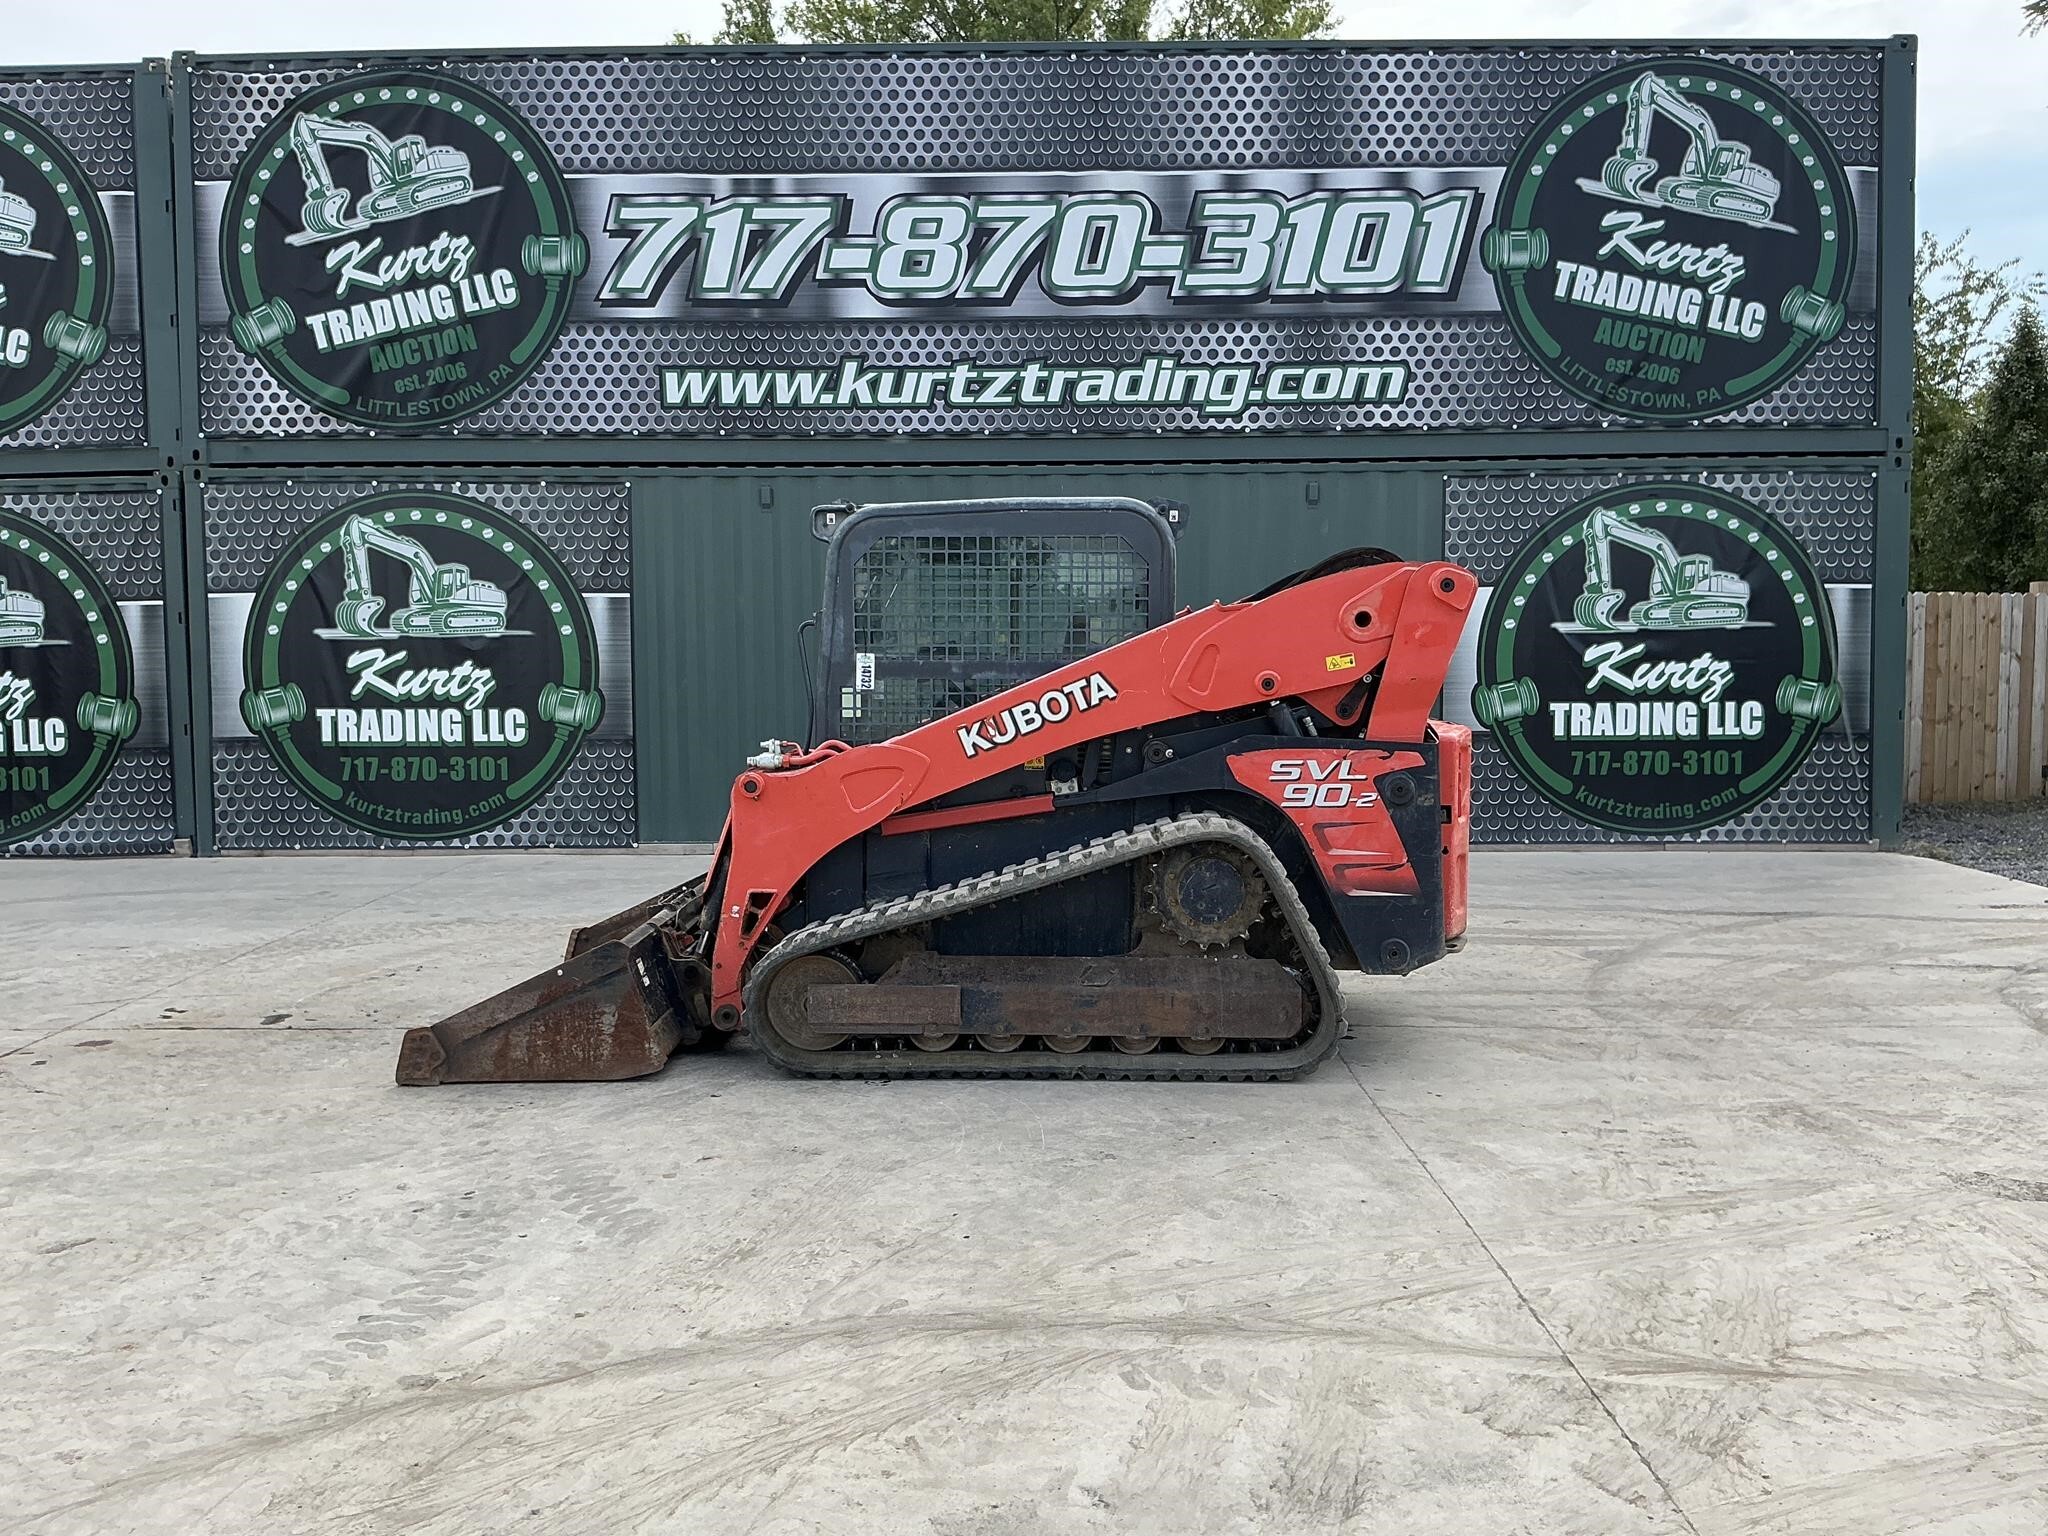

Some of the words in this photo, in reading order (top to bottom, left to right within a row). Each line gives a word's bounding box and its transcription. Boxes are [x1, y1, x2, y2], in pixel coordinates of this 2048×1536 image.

[325, 231, 477, 297] Kurtz
[604, 190, 1476, 303] 717-870-3101
[1597, 210, 1746, 295] Kurtz
[305, 284, 457, 352] TRADING
[460, 268, 520, 316] LLC
[1554, 261, 1704, 329] TRADING
[1707, 294, 1767, 342] LLC
[369, 323, 478, 373] AUCTION
[1593, 318, 1707, 363] AUCTION
[356, 382, 490, 417] LITTLESTOWN,
[488, 363, 514, 385] PA
[394, 374, 424, 394] est.
[427, 361, 467, 387] 2006
[661, 356, 1408, 414] www.kurtztrading.com
[1559, 357, 1691, 409] LITTLESTOWN,
[1697, 387, 1722, 405] PA
[1605, 357, 1633, 375] est.
[1636, 363, 1681, 384] 2006
[346, 648, 496, 711] Kurtz
[861, 664, 872, 689] 14732
[1583, 641, 1735, 704] Kurtz
[13, 717, 67, 756] LLC
[316, 708, 465, 746] TRADING
[472, 708, 528, 746] LLC
[957, 672, 1118, 758] KUBOTA
[1549, 702, 1700, 739] TRADING
[1707, 701, 1765, 739] LLC
[340, 756, 509, 781] 717-870-3101
[1268, 760, 1368, 781] SVL
[1571, 751, 1743, 775] 717-870-3101
[346, 791, 506, 825] kurtztrading.com
[1280, 783, 1379, 808] 90-2
[1575, 785, 1738, 819] kurtztrading.com
